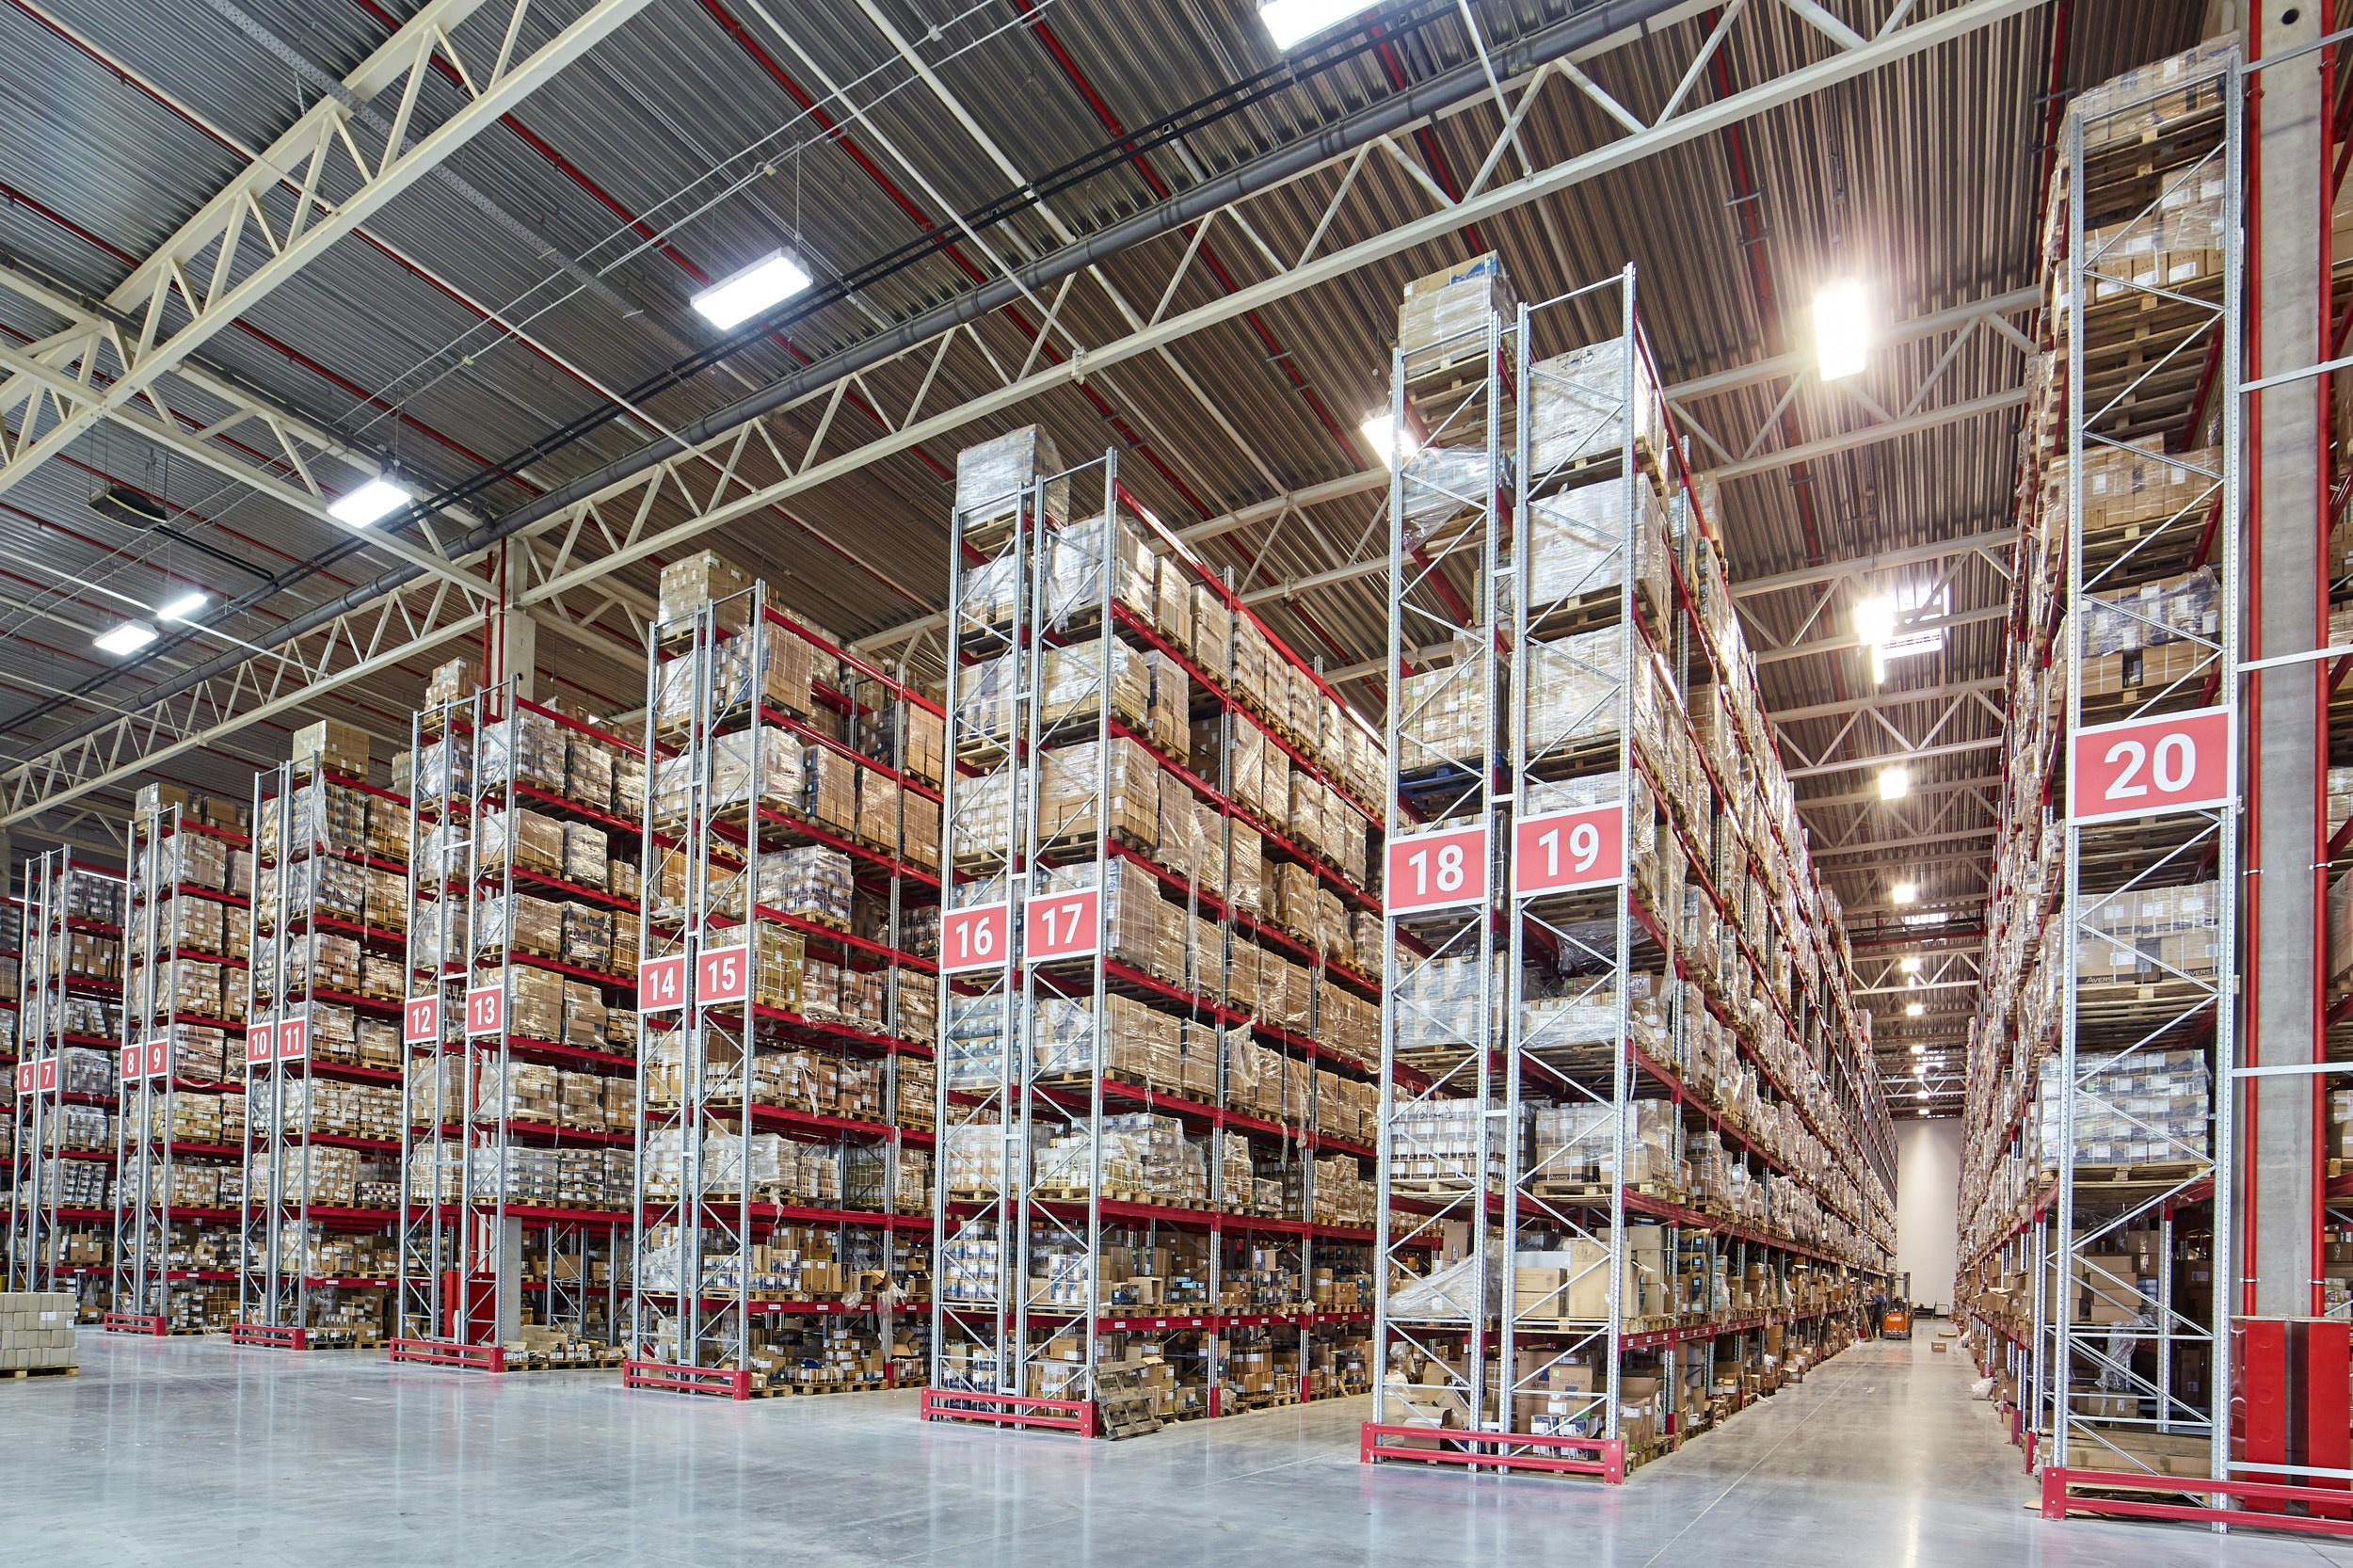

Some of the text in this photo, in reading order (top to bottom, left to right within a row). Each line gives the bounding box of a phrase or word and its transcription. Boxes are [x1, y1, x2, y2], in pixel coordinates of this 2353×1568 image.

[2104, 732, 2196, 801] 20
[1538, 823, 1599, 877] 19
[1408, 844, 1465, 896] 18
[955, 916, 994, 959] 16
[1041, 902, 1083, 947] 17
[648, 967, 676, 1001] 14
[707, 956, 736, 993] 15
[411, 1005, 431, 1034] 12
[474, 995, 495, 1026] 13
[251, 1031, 267, 1056] 10
[285, 1026, 300, 1052] 11
[127, 1051, 135, 1074] 8
[152, 1047, 161, 1070] 9
[23, 1068, 29, 1088] 6
[44, 1064, 52, 1085] 7
